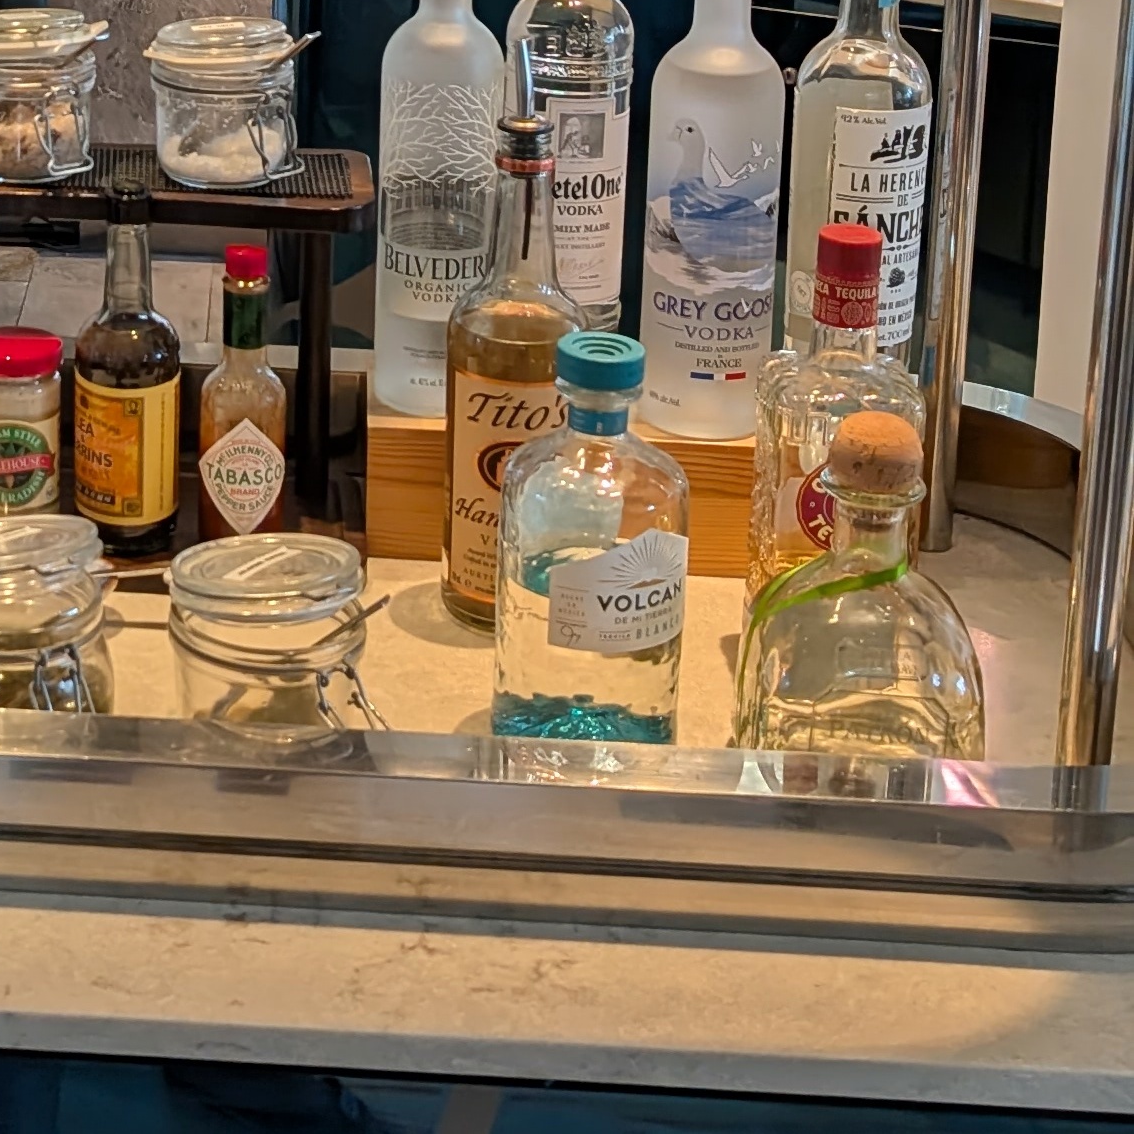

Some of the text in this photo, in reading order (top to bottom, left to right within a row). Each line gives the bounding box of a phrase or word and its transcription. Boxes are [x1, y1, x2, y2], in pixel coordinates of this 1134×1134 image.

[551, 173, 621, 200] etel One
[851, 172, 870, 192] LA
[897, 194, 909, 207] DE
[557, 204, 603, 216] VODKA
[554, 222, 610, 233] MILY MADE
[404, 279, 471, 293] ORGANIC
[835, 286, 877, 301] TEQUILA
[412, 291, 461, 303] VODKA
[653, 291, 772, 321] GREY GOOS
[684, 325, 754, 341] VODKA
[675, 341, 713, 353] DISTILLED
[732, 342, 760, 353] BOTTLED
[696, 358, 742, 368] FRANCE
[467, 392, 569, 431] Tito's
[14, 430, 42, 447] STYLE
[206, 462, 282, 485] TABASCO
[216, 483, 273, 511] PEPPER SAUCE
[230, 488, 260, 496] BRAND
[597, 578, 682, 612] VOLCAN
[615, 616, 628, 624] DE
